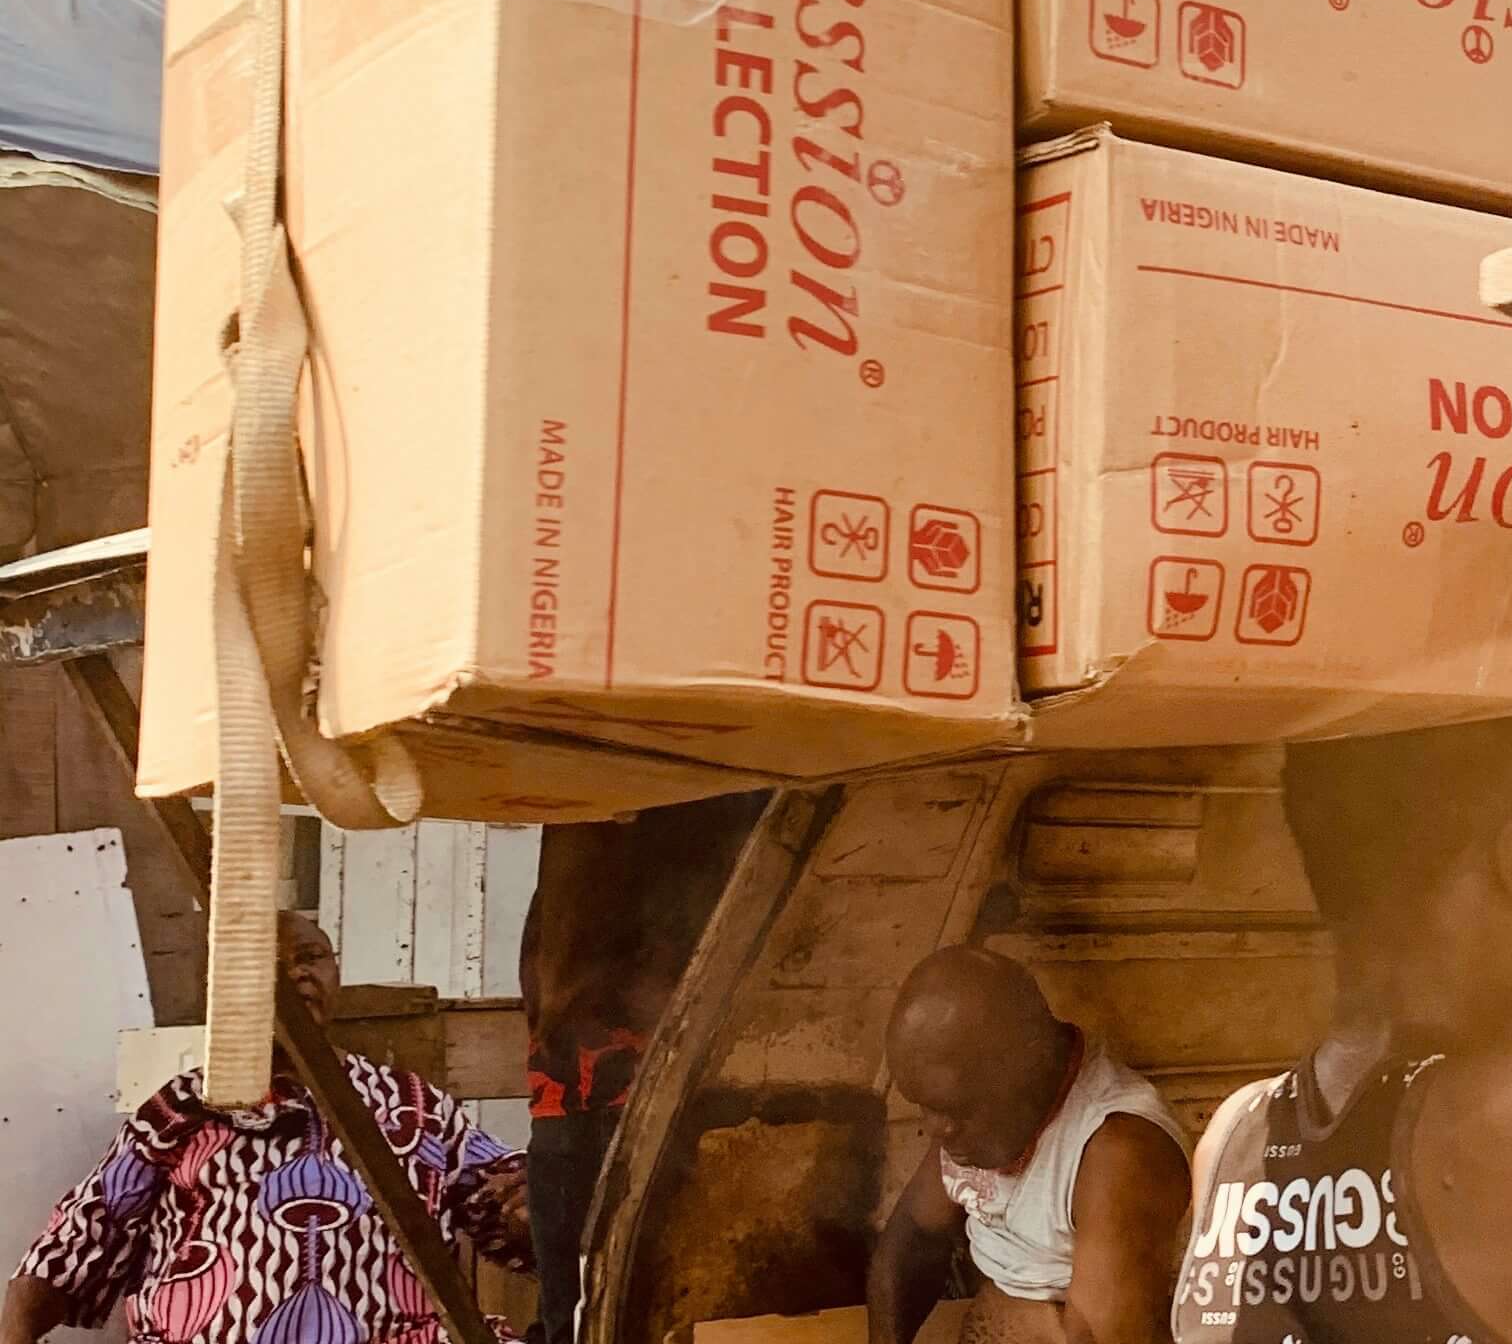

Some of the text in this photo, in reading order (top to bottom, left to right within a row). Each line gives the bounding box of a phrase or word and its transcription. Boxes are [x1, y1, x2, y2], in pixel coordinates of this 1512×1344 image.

[1140, 196, 1341, 254] MADE IN NIGERIA
[1151, 414, 1320, 452] HAIR PRODUCT
[526, 418, 568, 682] MADE IN NIGERIA
[762, 486, 797, 684] HAIR PRODUCT
